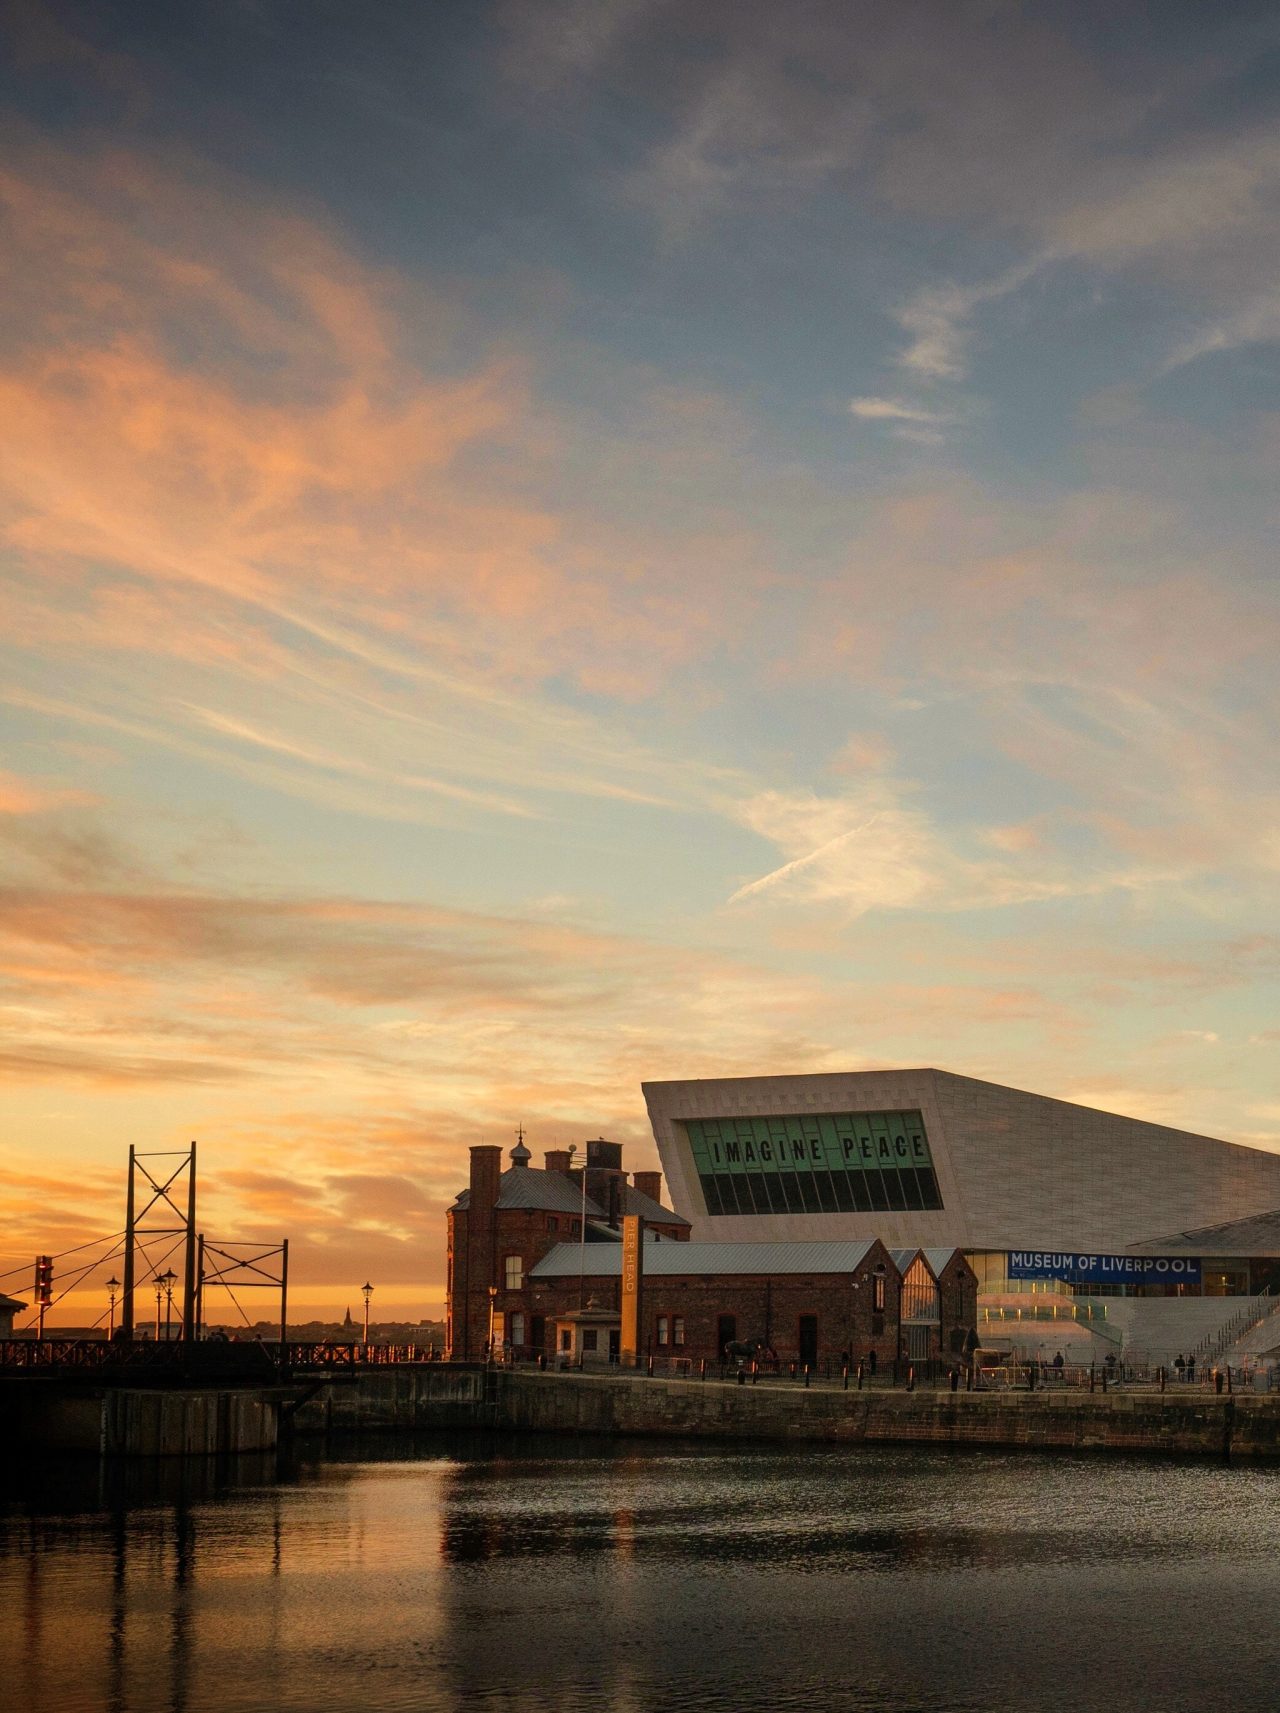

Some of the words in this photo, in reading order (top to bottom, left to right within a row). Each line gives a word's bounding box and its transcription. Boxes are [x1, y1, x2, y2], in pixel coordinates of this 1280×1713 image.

[713, 1138, 823, 1163] IMAGINE
[843, 1134, 926, 1159] PEACE
[627, 1222, 635, 1249] PIER
[626, 1254, 634, 1292] HEAD
[1011, 1252, 1073, 1269] MUSEUM
[1078, 1256, 1097, 1270] OF
[1102, 1257, 1197, 1273] LIVERPOOL
